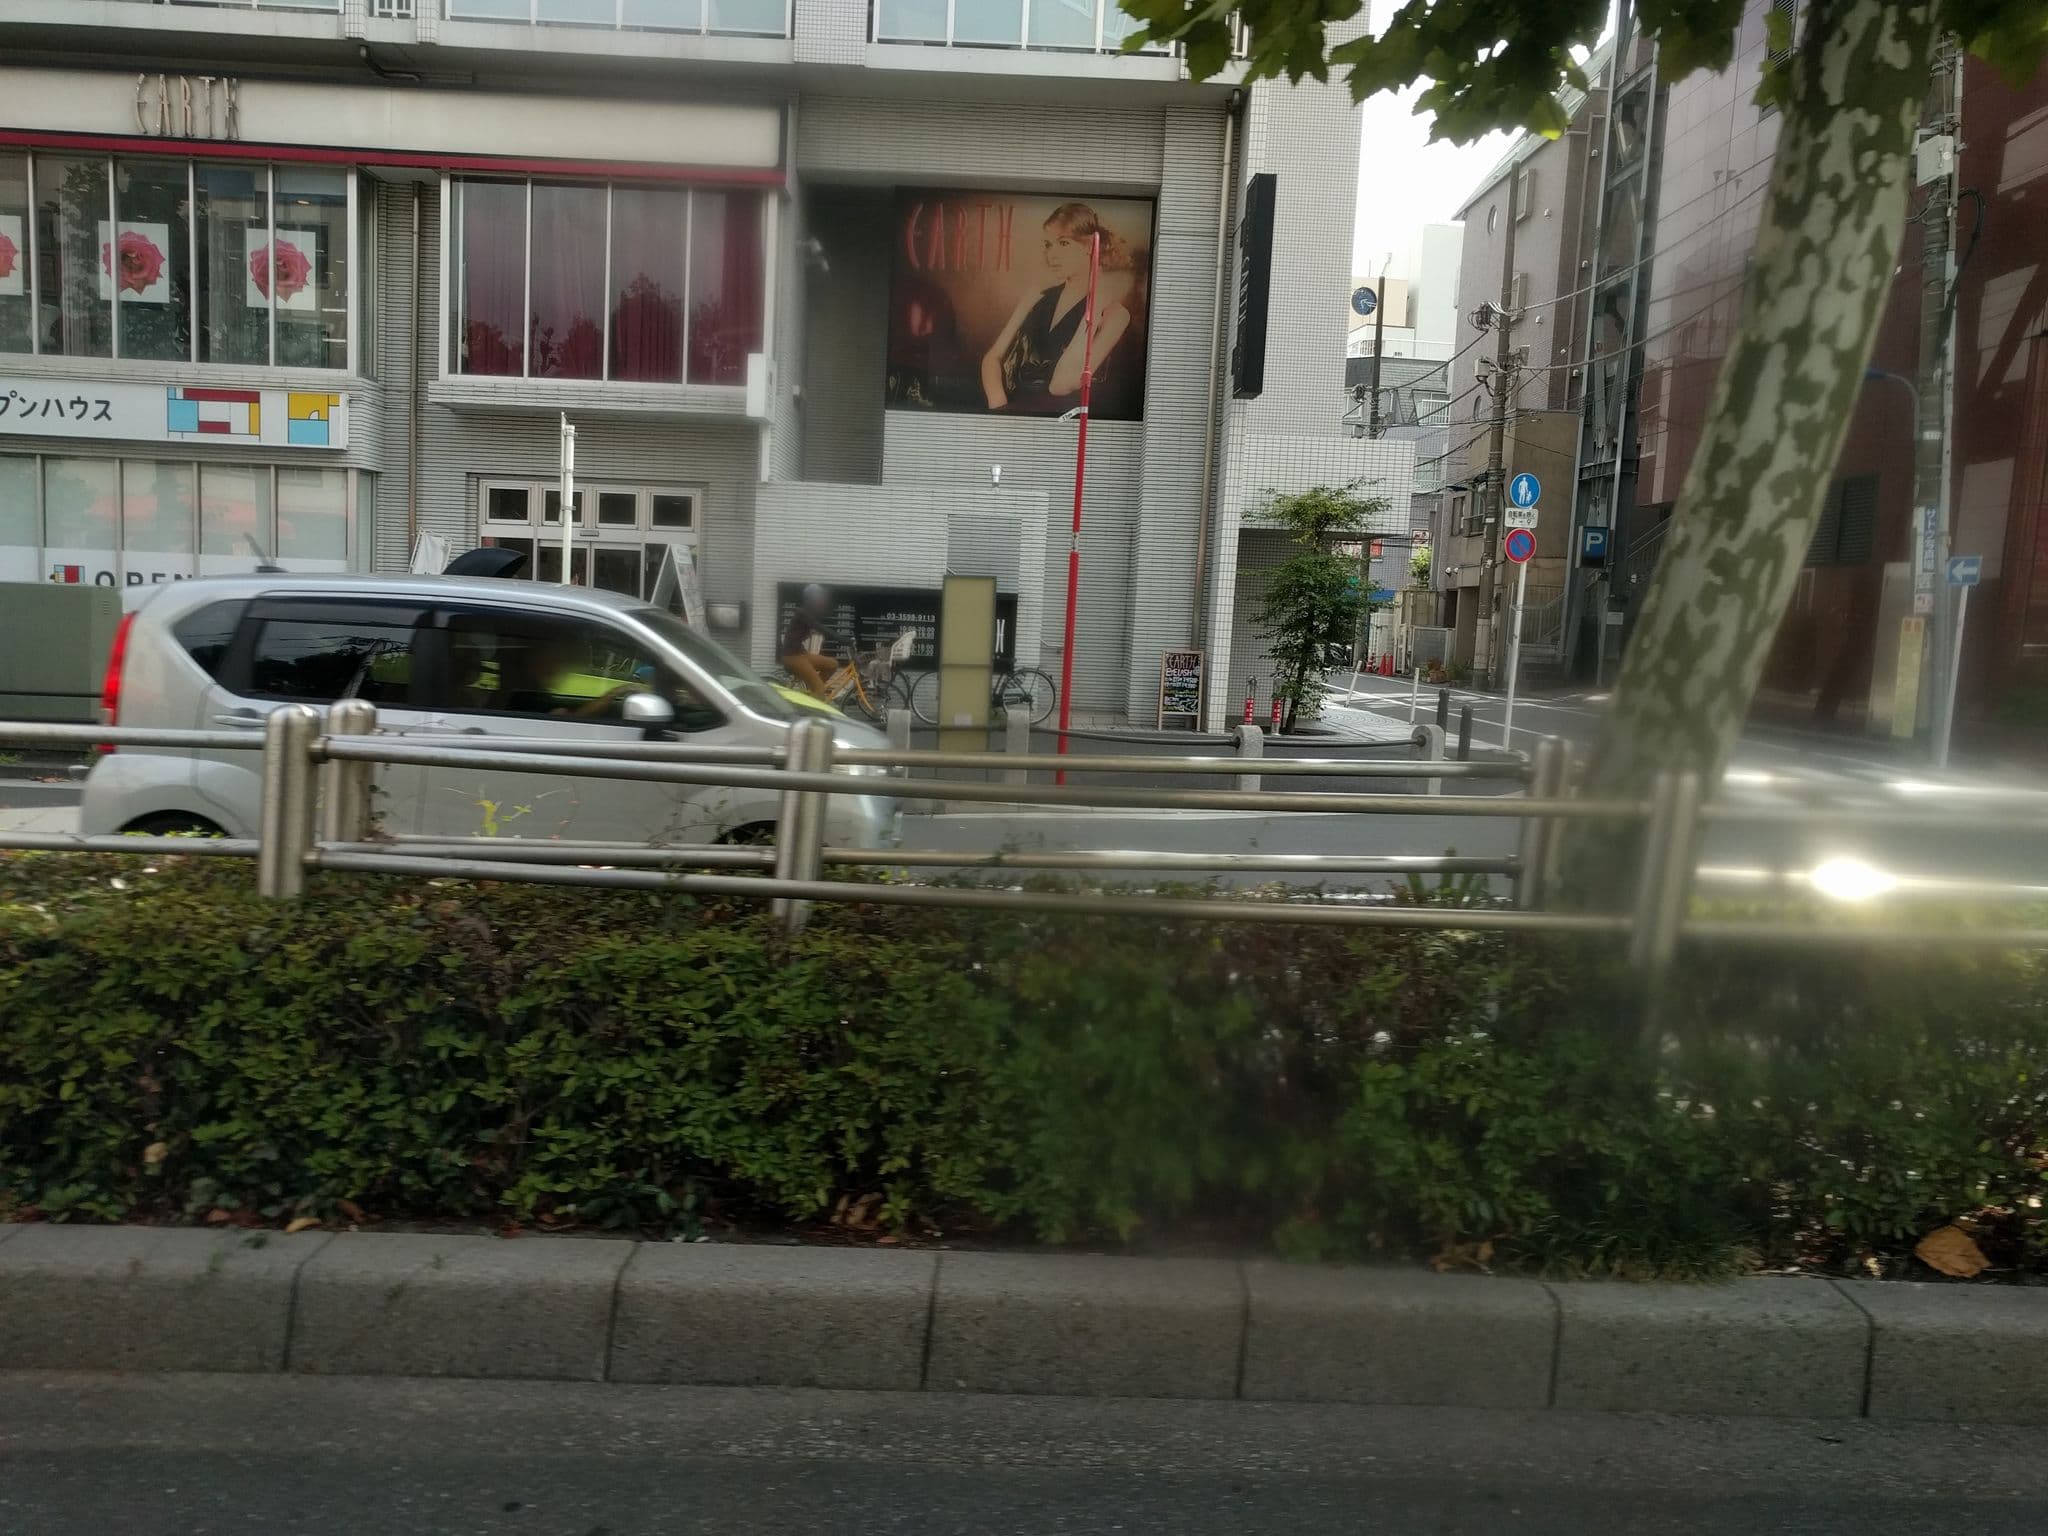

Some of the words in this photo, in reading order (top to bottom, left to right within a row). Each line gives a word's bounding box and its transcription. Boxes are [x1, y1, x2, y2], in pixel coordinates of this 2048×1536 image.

[135, 73, 240, 139] EARTH
[906, 203, 1015, 271] EARTH
[0, 390, 112, 421] プンハウス
[1586, 532, 1603, 551] P
